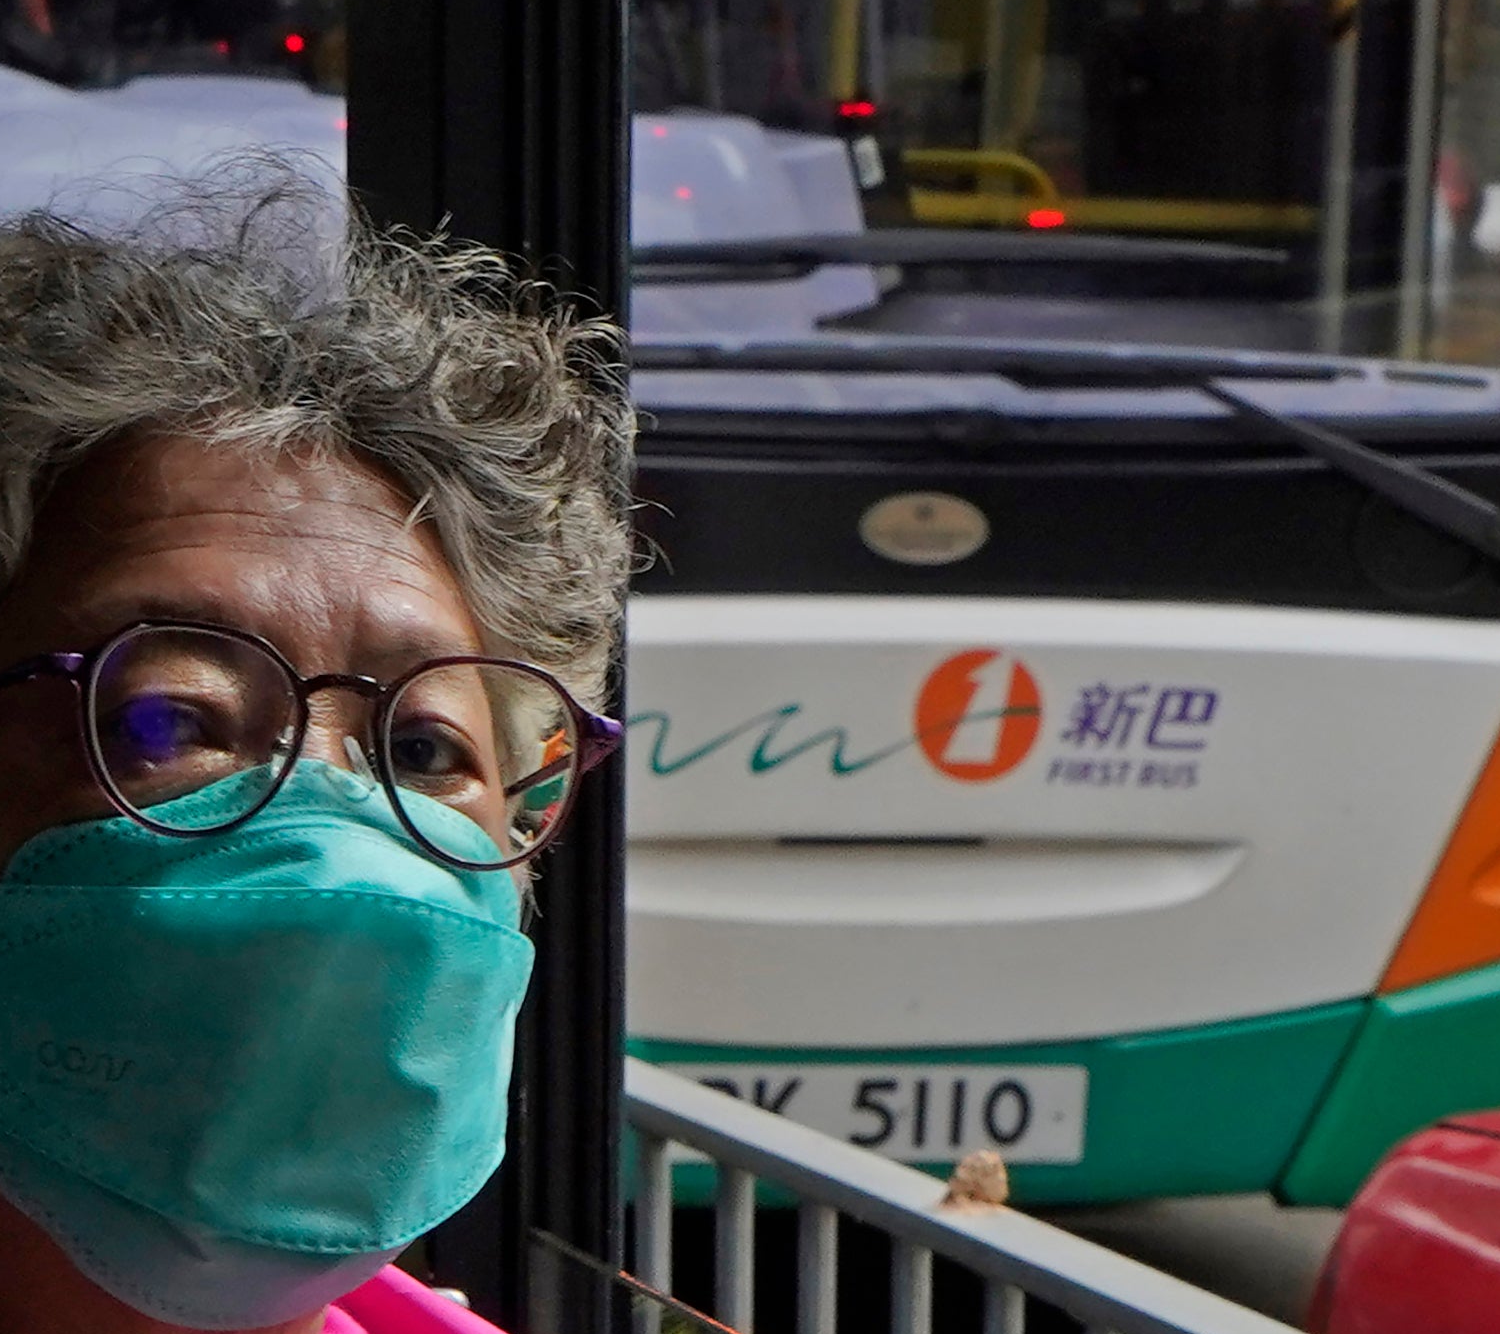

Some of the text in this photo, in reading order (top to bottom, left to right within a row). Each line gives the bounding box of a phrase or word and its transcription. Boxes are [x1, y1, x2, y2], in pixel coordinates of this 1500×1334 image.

[1061, 682, 1220, 750] 新巴
[1046, 757, 1199, 789] FIRST BUS
[848, 1077, 1033, 1148] 5110
